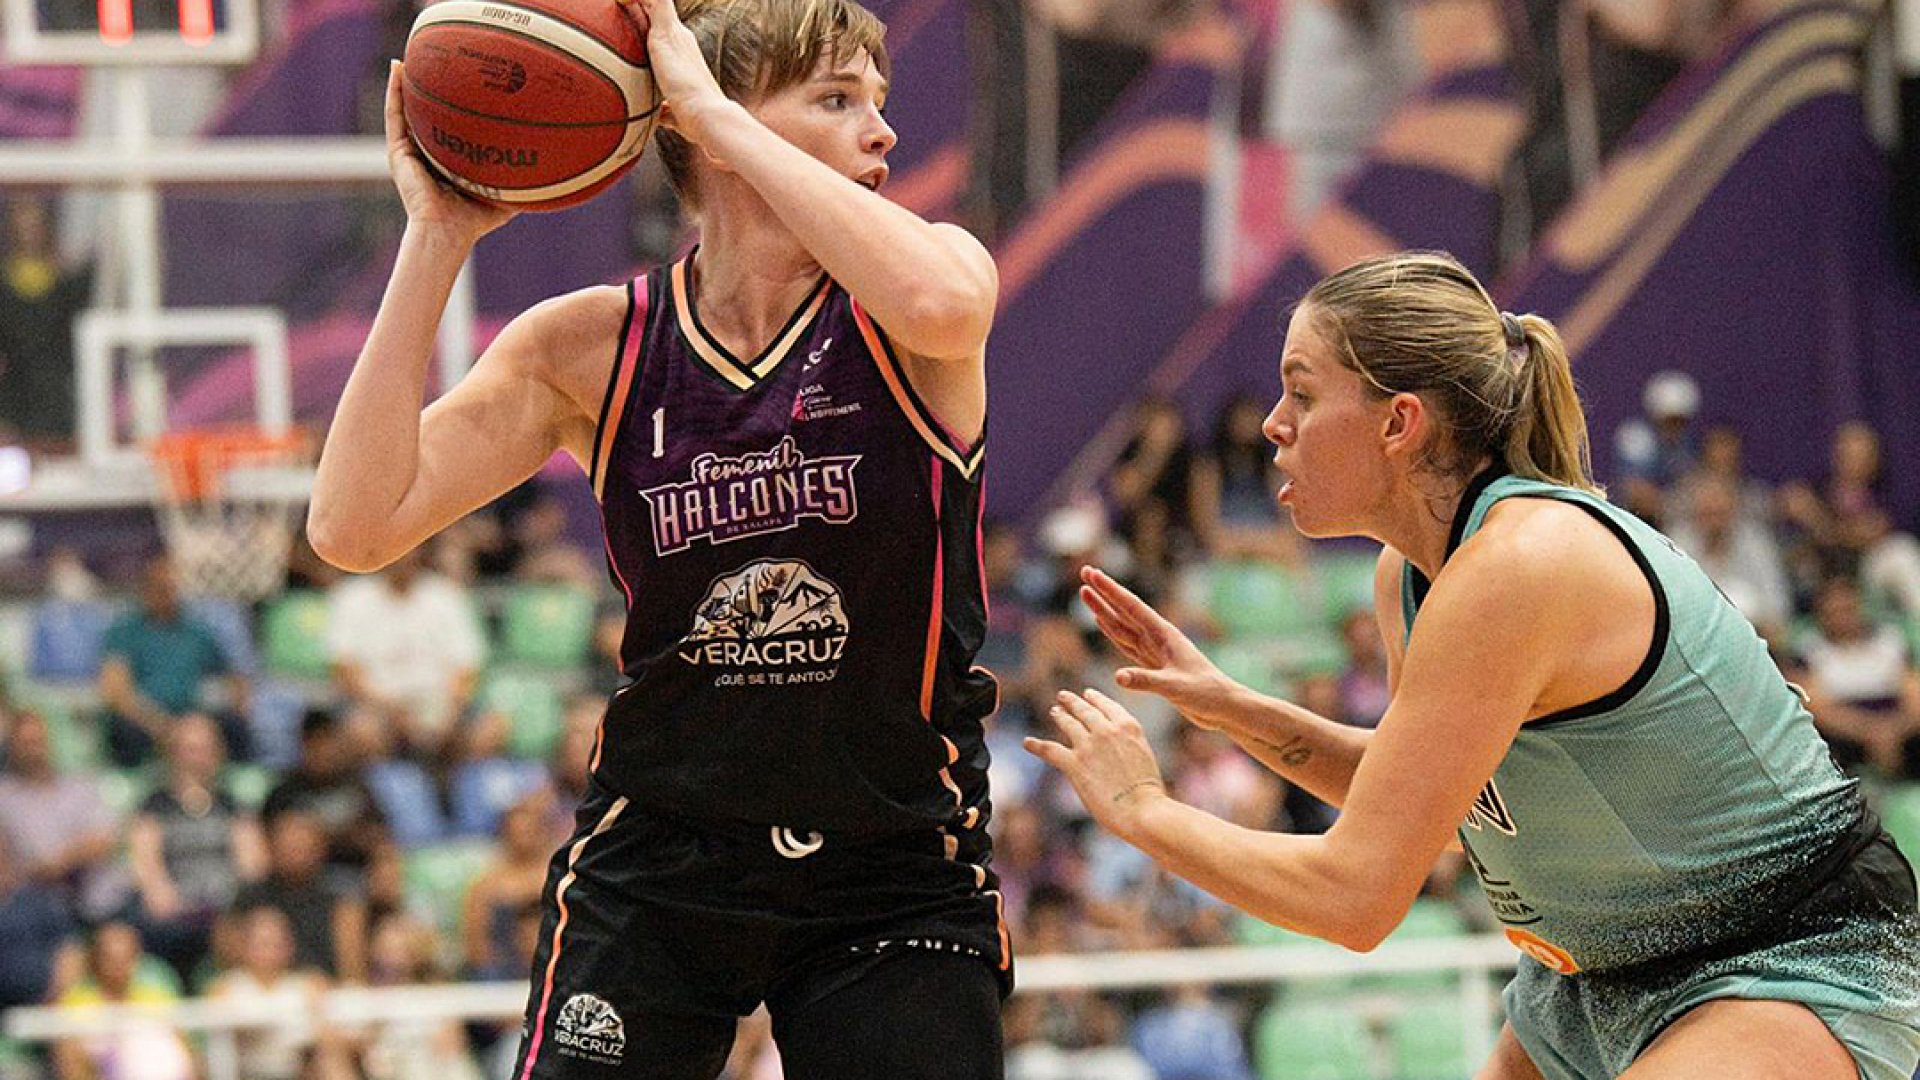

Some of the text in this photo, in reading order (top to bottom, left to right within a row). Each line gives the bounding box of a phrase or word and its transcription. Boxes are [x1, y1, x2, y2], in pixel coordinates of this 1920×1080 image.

[432, 125, 537, 167] molten
[652, 407, 665, 458] 1
[699, 443, 798, 486] Femenil
[656, 465, 850, 548] HALCONES
[678, 637, 848, 666] VERACRUZ
[768, 671, 785, 685] TE
